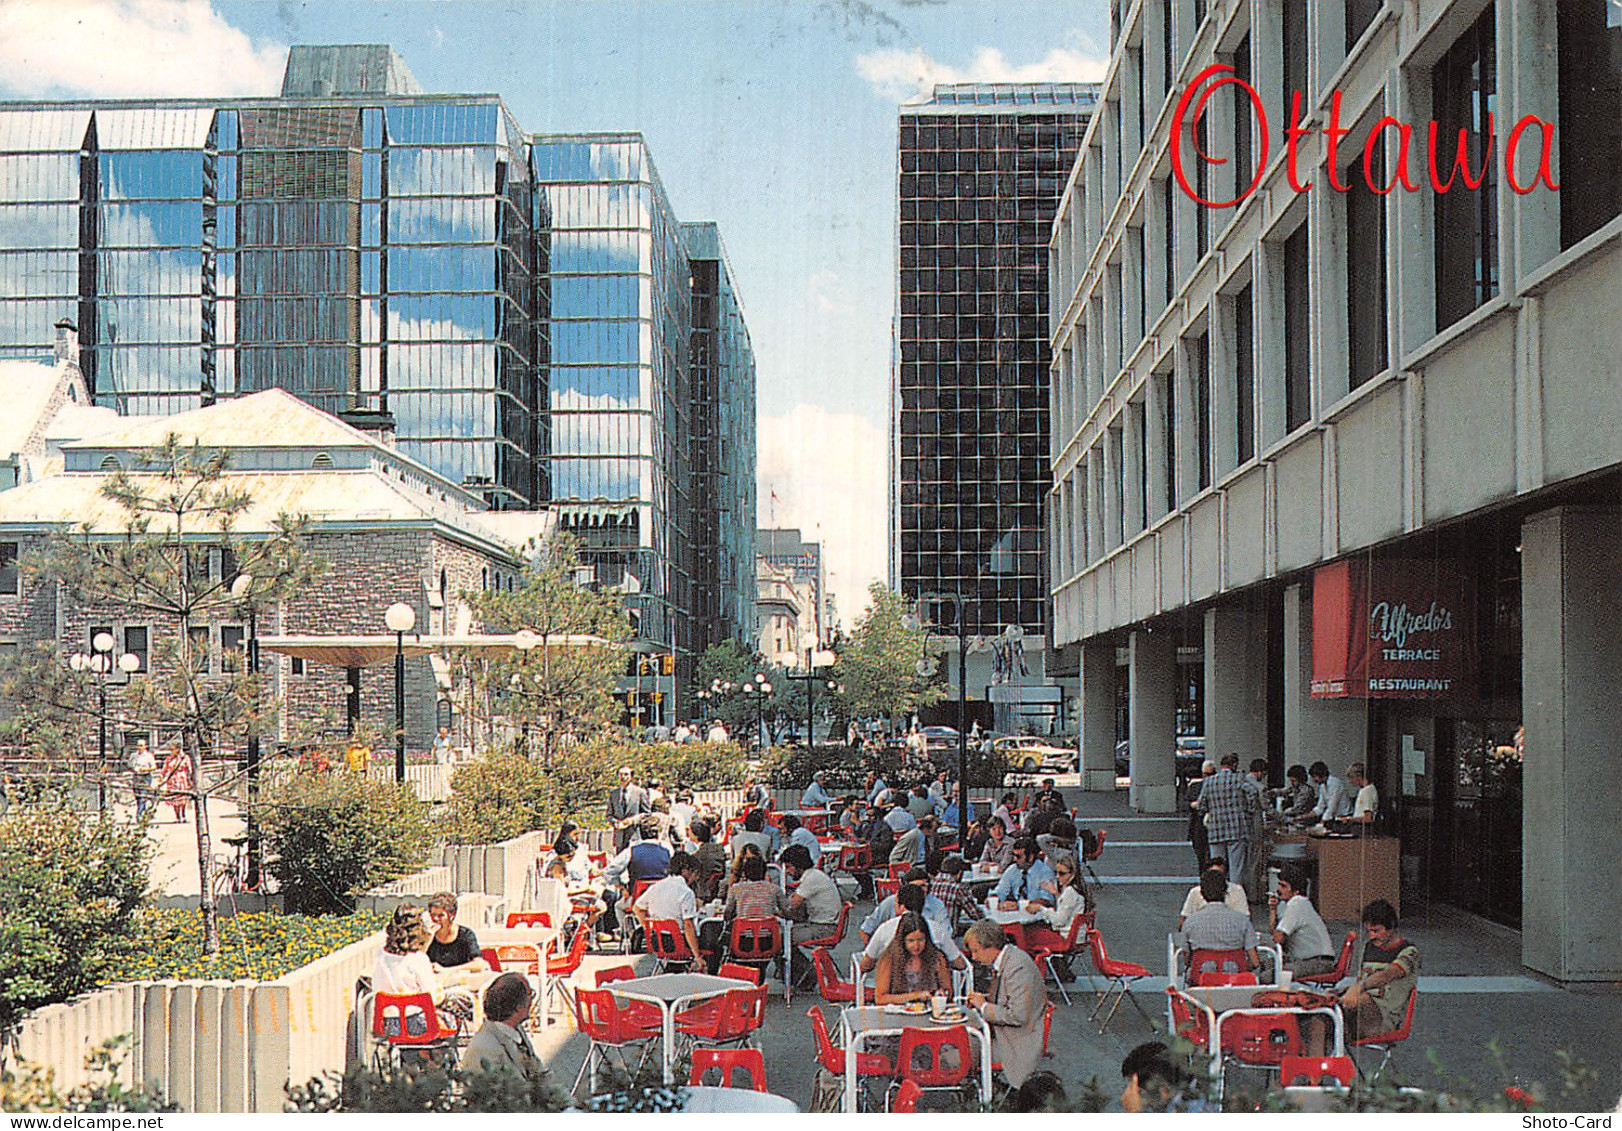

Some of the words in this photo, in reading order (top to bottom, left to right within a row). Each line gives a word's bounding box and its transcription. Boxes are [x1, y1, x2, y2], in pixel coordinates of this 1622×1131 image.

[1370, 601, 1451, 648] Alfredo's
[1382, 649, 1440, 661] TERRACE
[1368, 678, 1450, 691] RESTAURANT
